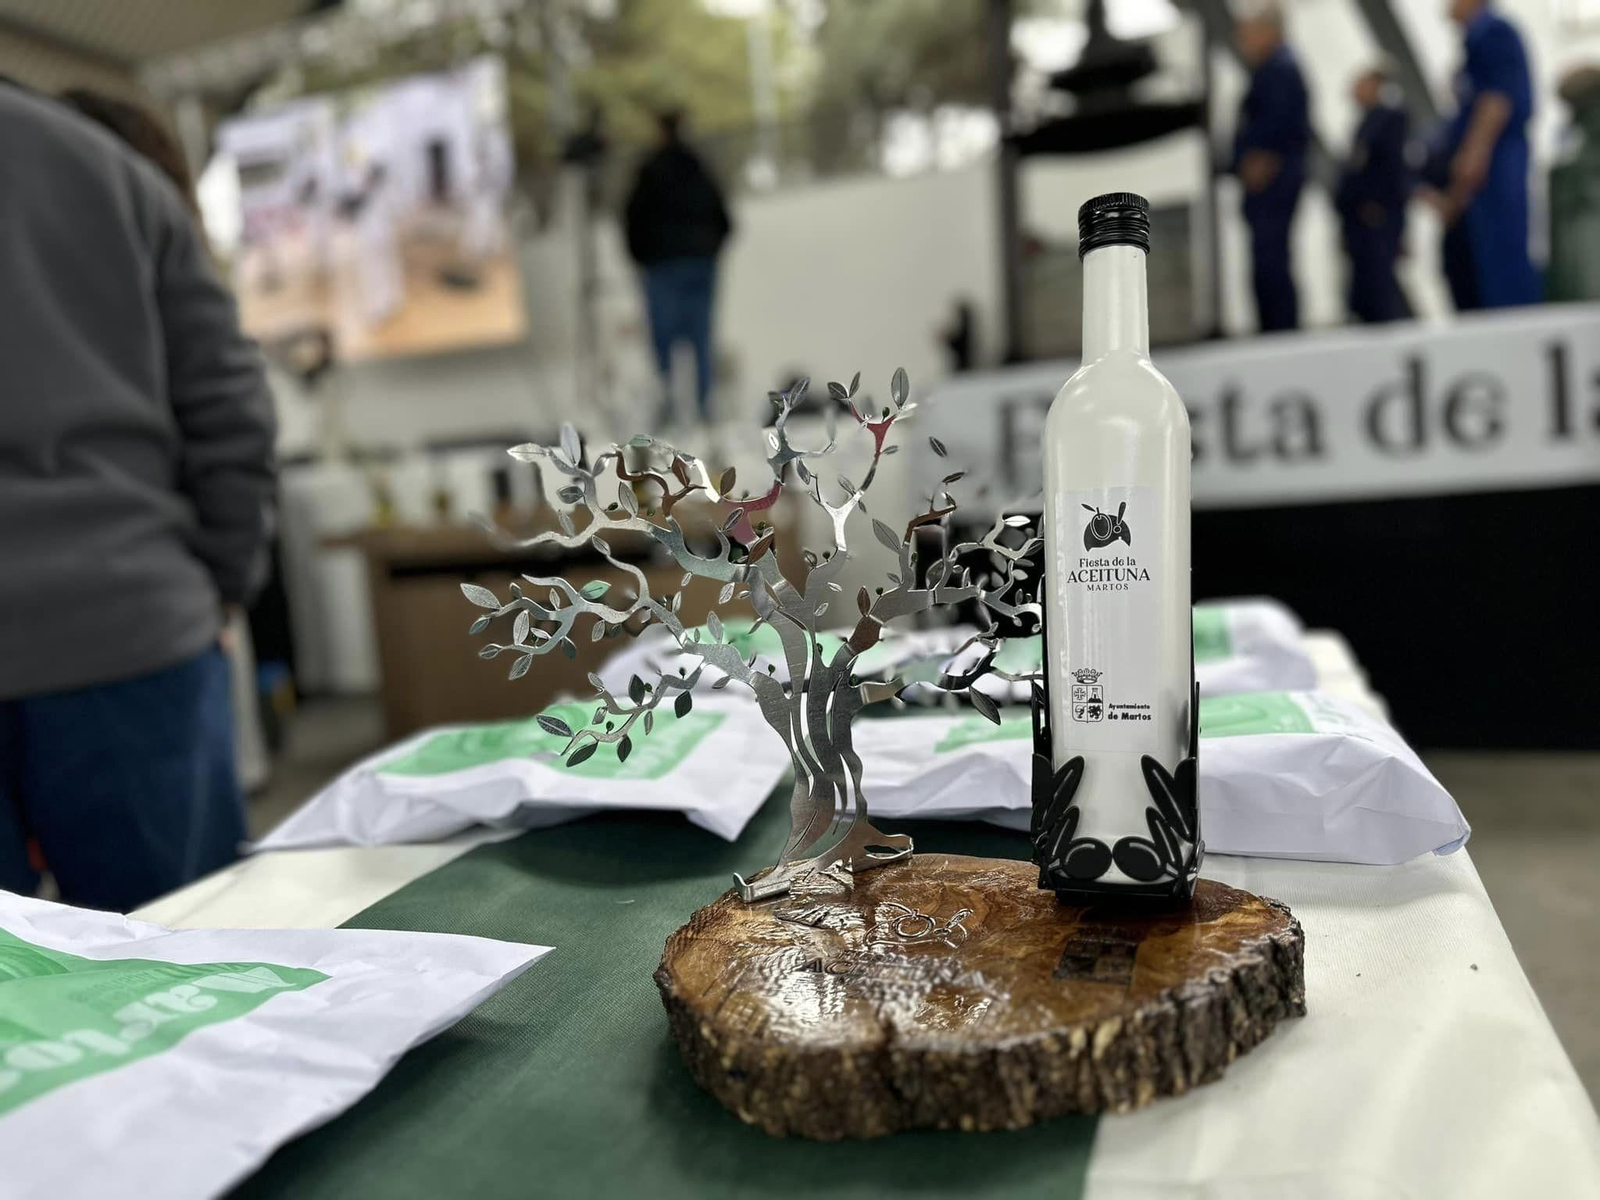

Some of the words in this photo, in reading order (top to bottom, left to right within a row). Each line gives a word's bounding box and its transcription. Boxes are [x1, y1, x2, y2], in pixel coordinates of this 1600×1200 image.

[995, 378, 1326, 490] Fta
[1359, 352, 1509, 460] de
[1546, 340, 1600, 440] l
[1079, 558, 1110, 568] Fiesta
[1112, 556, 1125, 567] de
[1126, 556, 1137, 566] la
[1067, 567, 1151, 583] ACEITUNA
[1086, 583, 1130, 592] MARTOS
[1107, 711, 1119, 720] de
[1121, 712, 1152, 721] Martos
